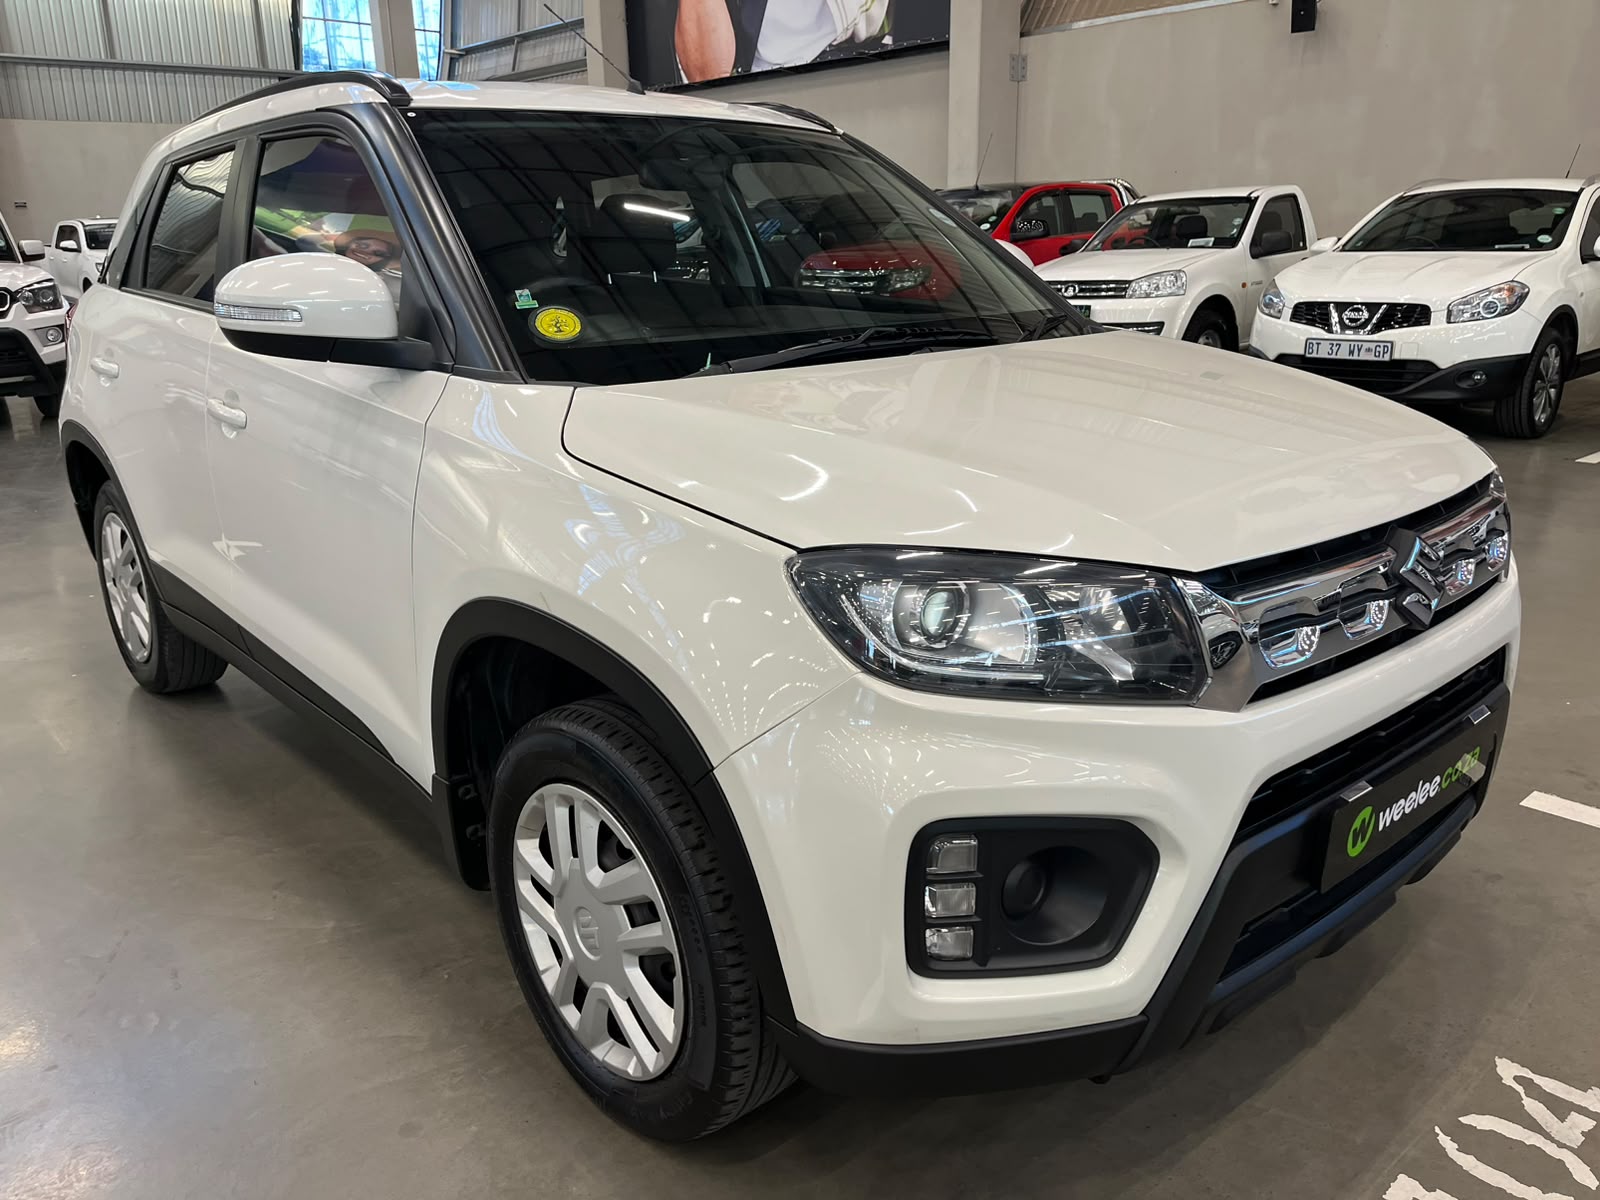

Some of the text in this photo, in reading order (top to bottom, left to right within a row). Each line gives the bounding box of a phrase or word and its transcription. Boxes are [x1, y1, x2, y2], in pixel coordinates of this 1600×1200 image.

[1308, 342, 1321, 355] BT
[1328, 343, 1342, 356] 37
[1374, 345, 1389, 358] GP
